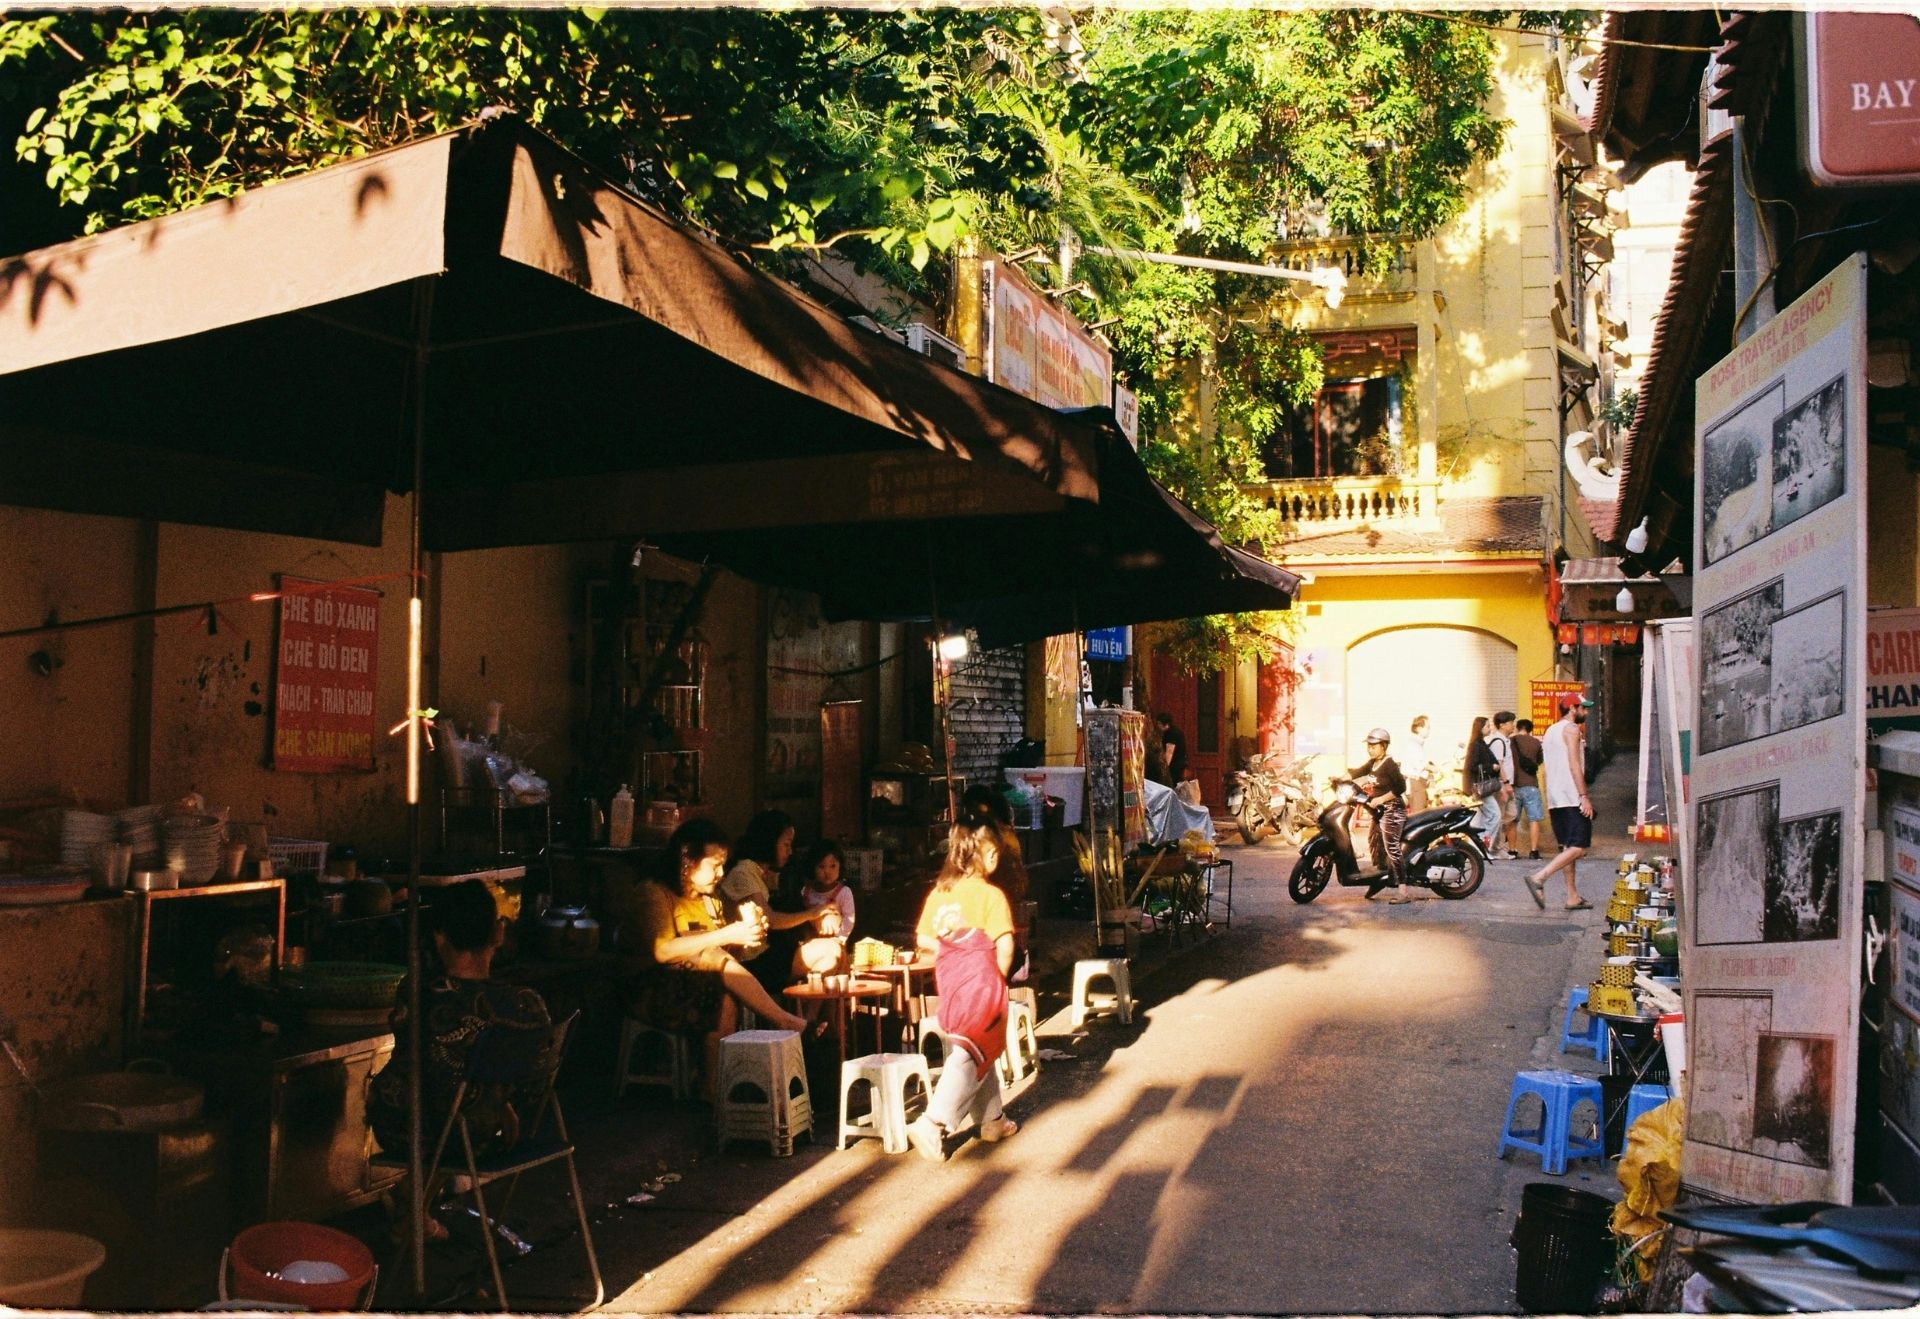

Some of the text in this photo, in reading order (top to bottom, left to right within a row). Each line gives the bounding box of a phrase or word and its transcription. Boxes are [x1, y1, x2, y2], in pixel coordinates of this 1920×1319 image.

[1851, 79, 1917, 111] BAY
[1710, 281, 1834, 392] ROSE TRAVEL AGENCY
[336, 602, 376, 632] XANH
[340, 645, 369, 673] ĐEN
[1091, 638, 1123, 658] HUYỆN
